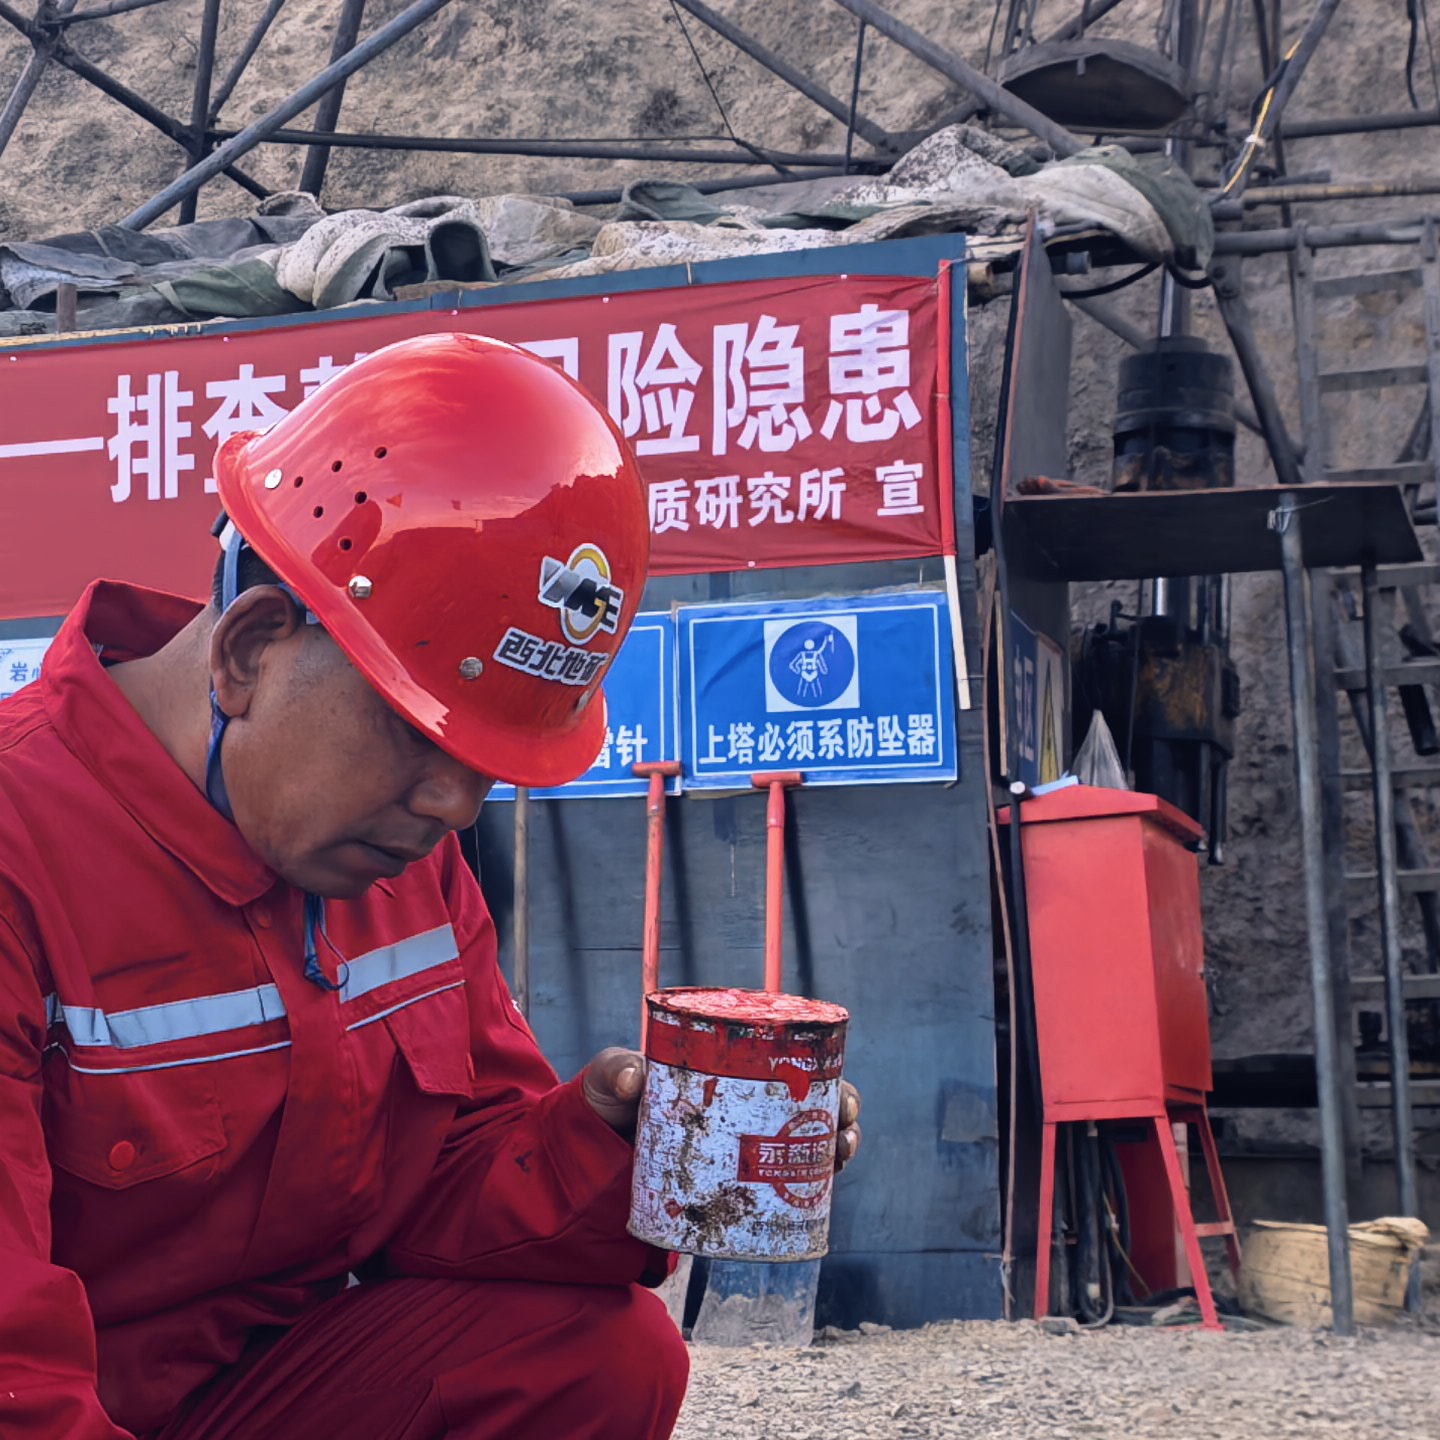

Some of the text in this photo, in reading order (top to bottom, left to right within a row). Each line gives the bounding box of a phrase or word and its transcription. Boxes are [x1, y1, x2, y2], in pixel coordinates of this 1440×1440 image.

[875, 459, 925, 517] 宣
[699, 714, 937, 765] 上塔必须系防坠器
